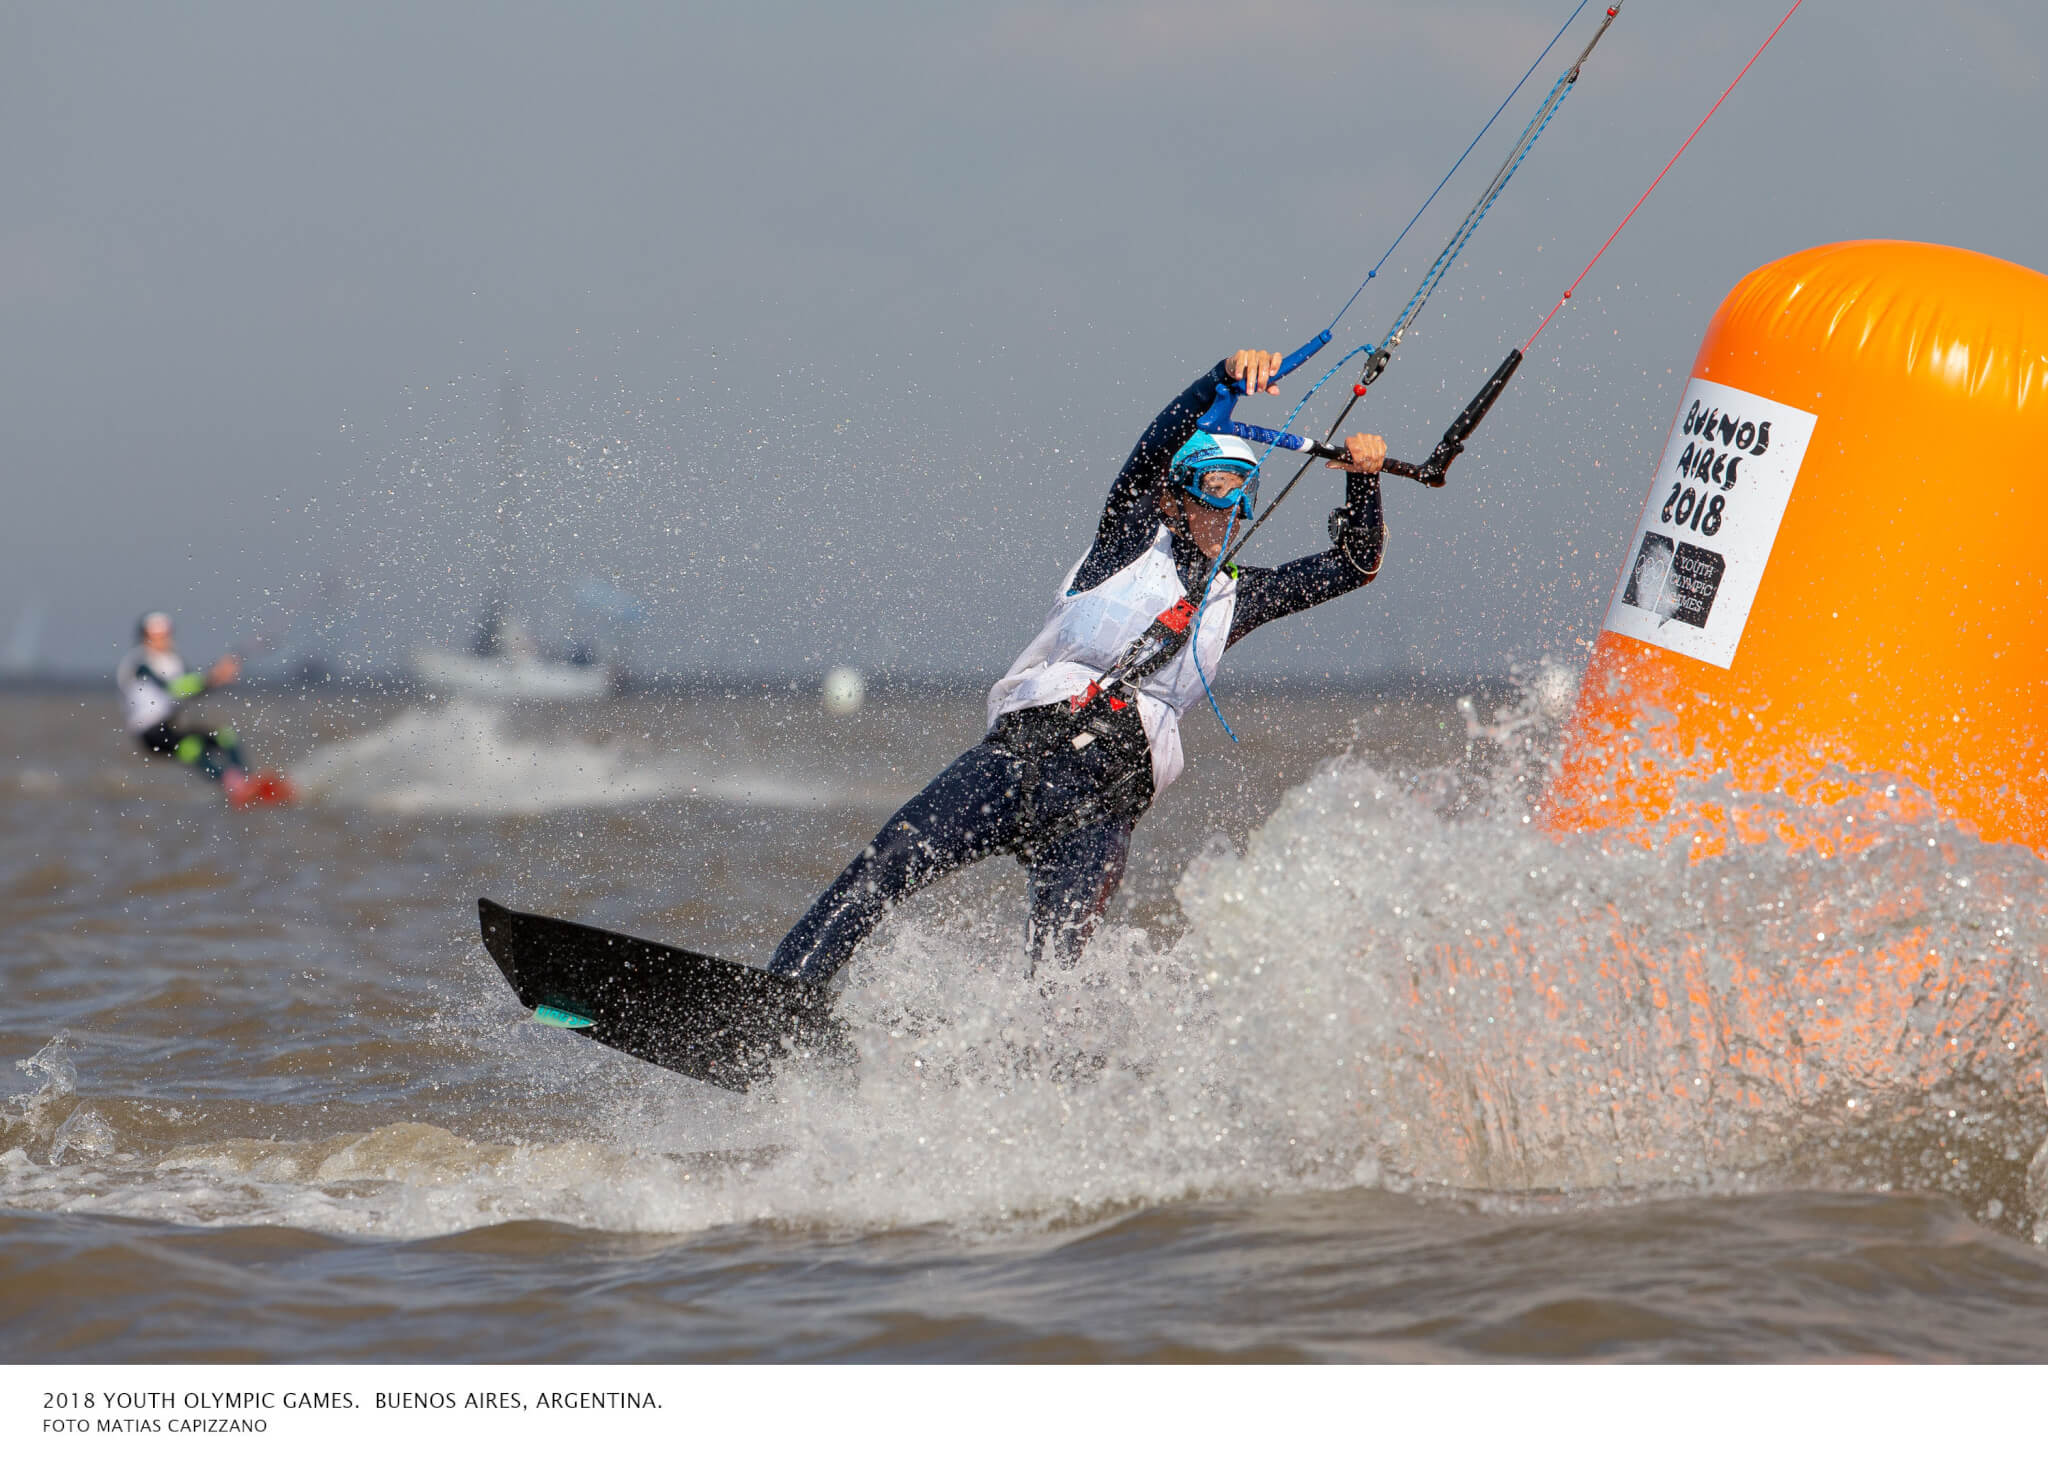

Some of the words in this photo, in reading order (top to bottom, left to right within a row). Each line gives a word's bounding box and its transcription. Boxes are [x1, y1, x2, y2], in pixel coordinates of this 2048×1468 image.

[1683, 399, 1772, 456] BUENOS
[1676, 441, 1743, 491] AIRES
[1661, 482, 1726, 536] 2018
[1670, 573, 1713, 597] OLYMPIC
[1680, 556, 1714, 578] YOUTH
